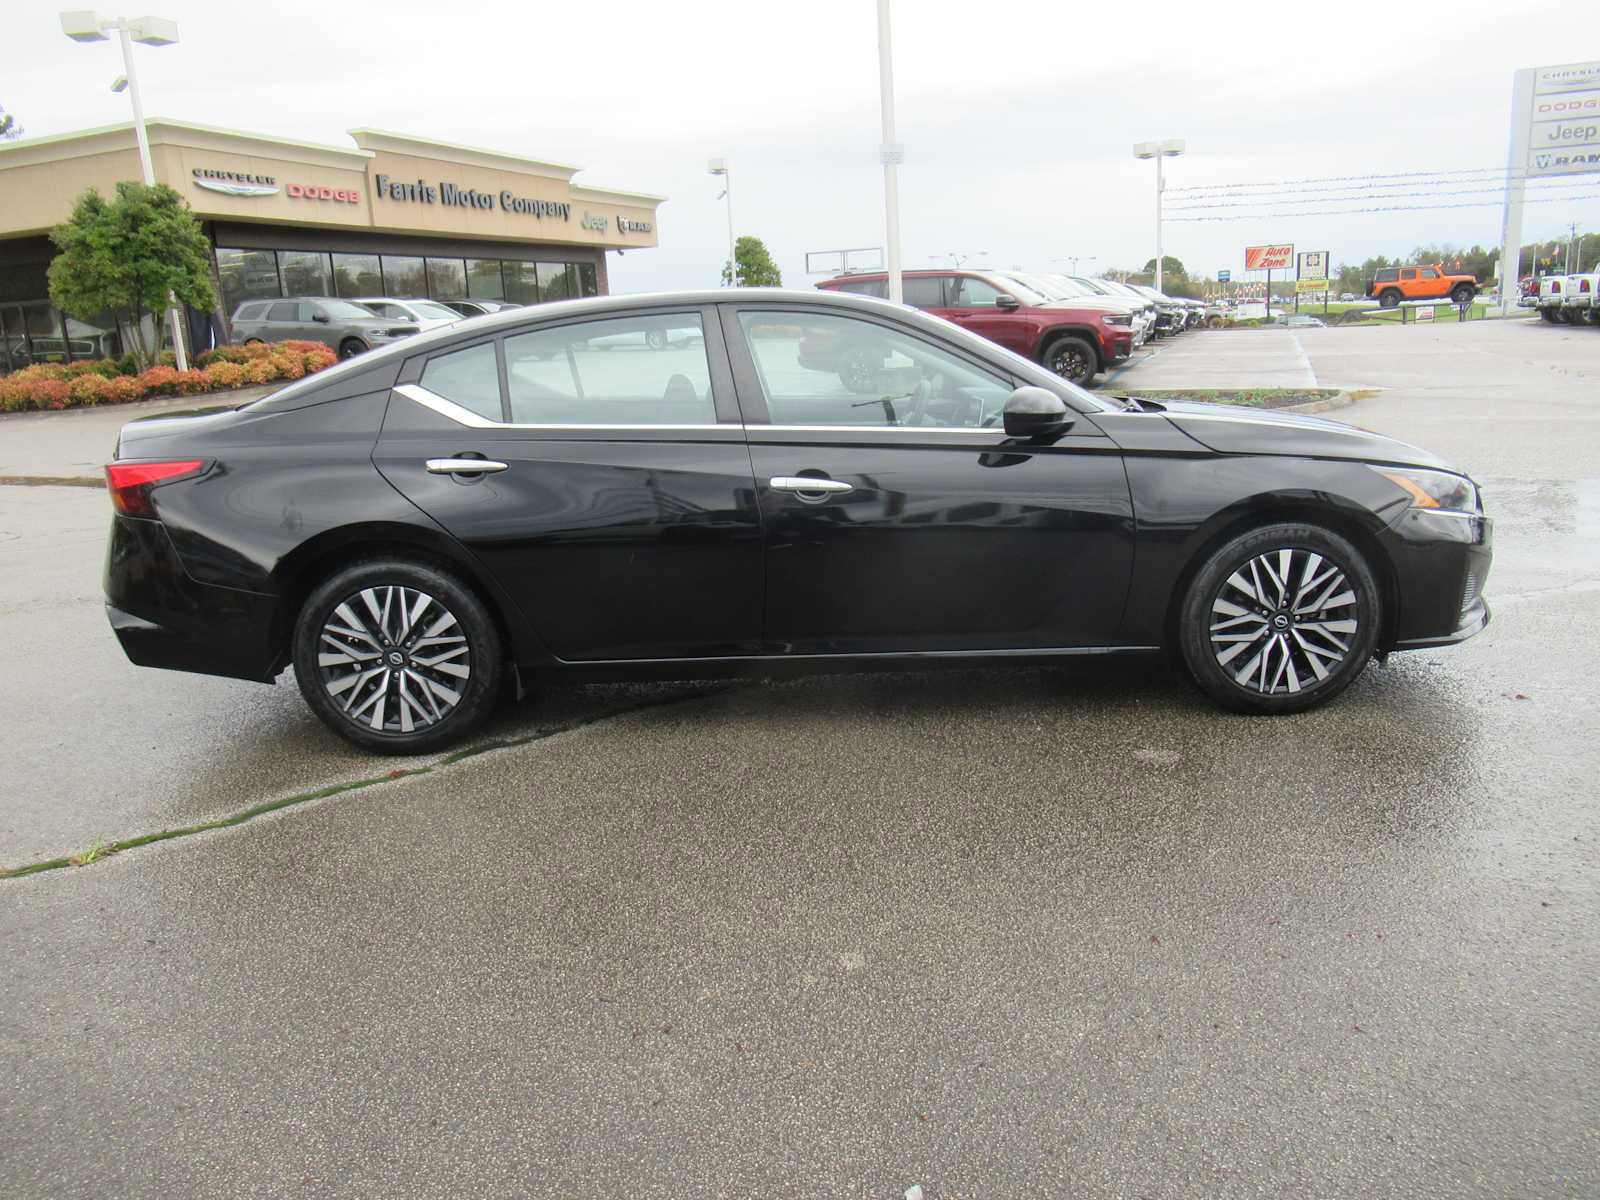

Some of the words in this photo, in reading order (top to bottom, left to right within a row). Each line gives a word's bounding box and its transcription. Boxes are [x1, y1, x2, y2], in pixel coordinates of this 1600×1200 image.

[1539, 100, 1600, 112] DODG
[1549, 125, 1597, 141] Jeep
[192, 168, 276, 185] CHRYSLER
[287, 183, 361, 204] DODGE
[376, 174, 436, 205] Farris
[440, 182, 497, 211] Motor
[500, 190, 571, 222] Company
[581, 210, 608, 234] Jeep
[1266, 247, 1290, 257] Auto
[1260, 258, 1286, 268] Zone
